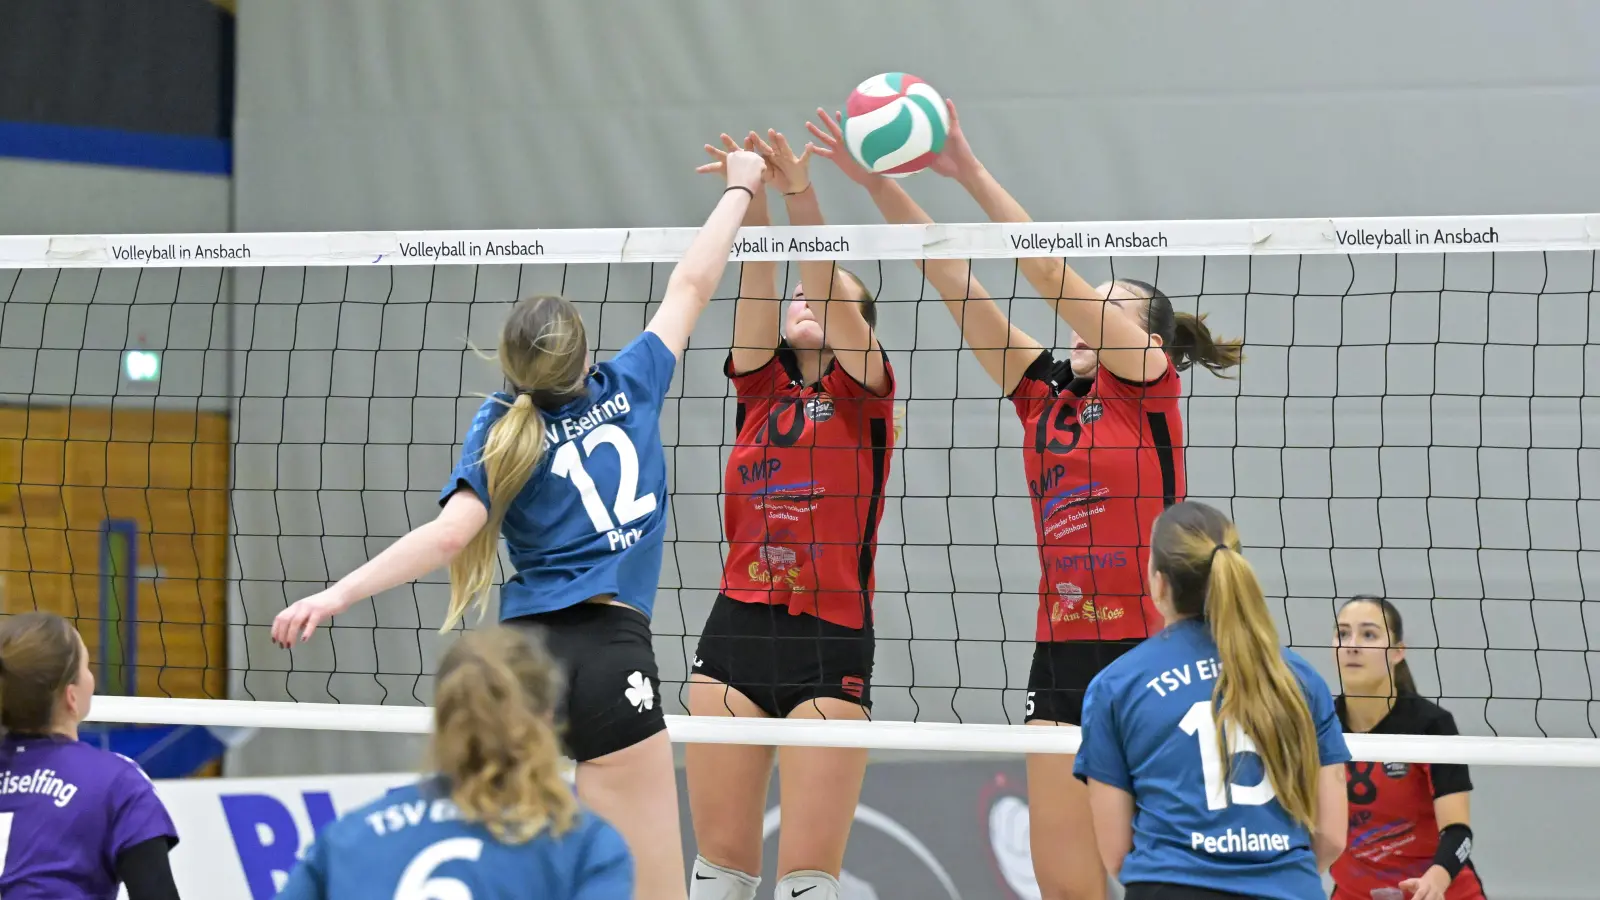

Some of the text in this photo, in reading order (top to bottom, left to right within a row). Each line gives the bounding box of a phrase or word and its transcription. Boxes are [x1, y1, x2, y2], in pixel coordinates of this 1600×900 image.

[399, 240, 544, 260] Volleyball in Ansbach
[731, 236, 850, 257] yball in Ansbach
[1010, 231, 1168, 253] Volleyball in Ansbach
[1336, 226, 1499, 250] Volleyball in Ansbach
[112, 243, 251, 264] Volleyball in Ansbach
[561, 391, 630, 441] Eselfing
[1035, 400, 1082, 455] 15
[551, 423, 657, 533] 12
[737, 458, 782, 485] RMP
[1146, 664, 1192, 697] TSV
[365, 799, 427, 836] TSV
[1191, 827, 1290, 853] Pechlaner
